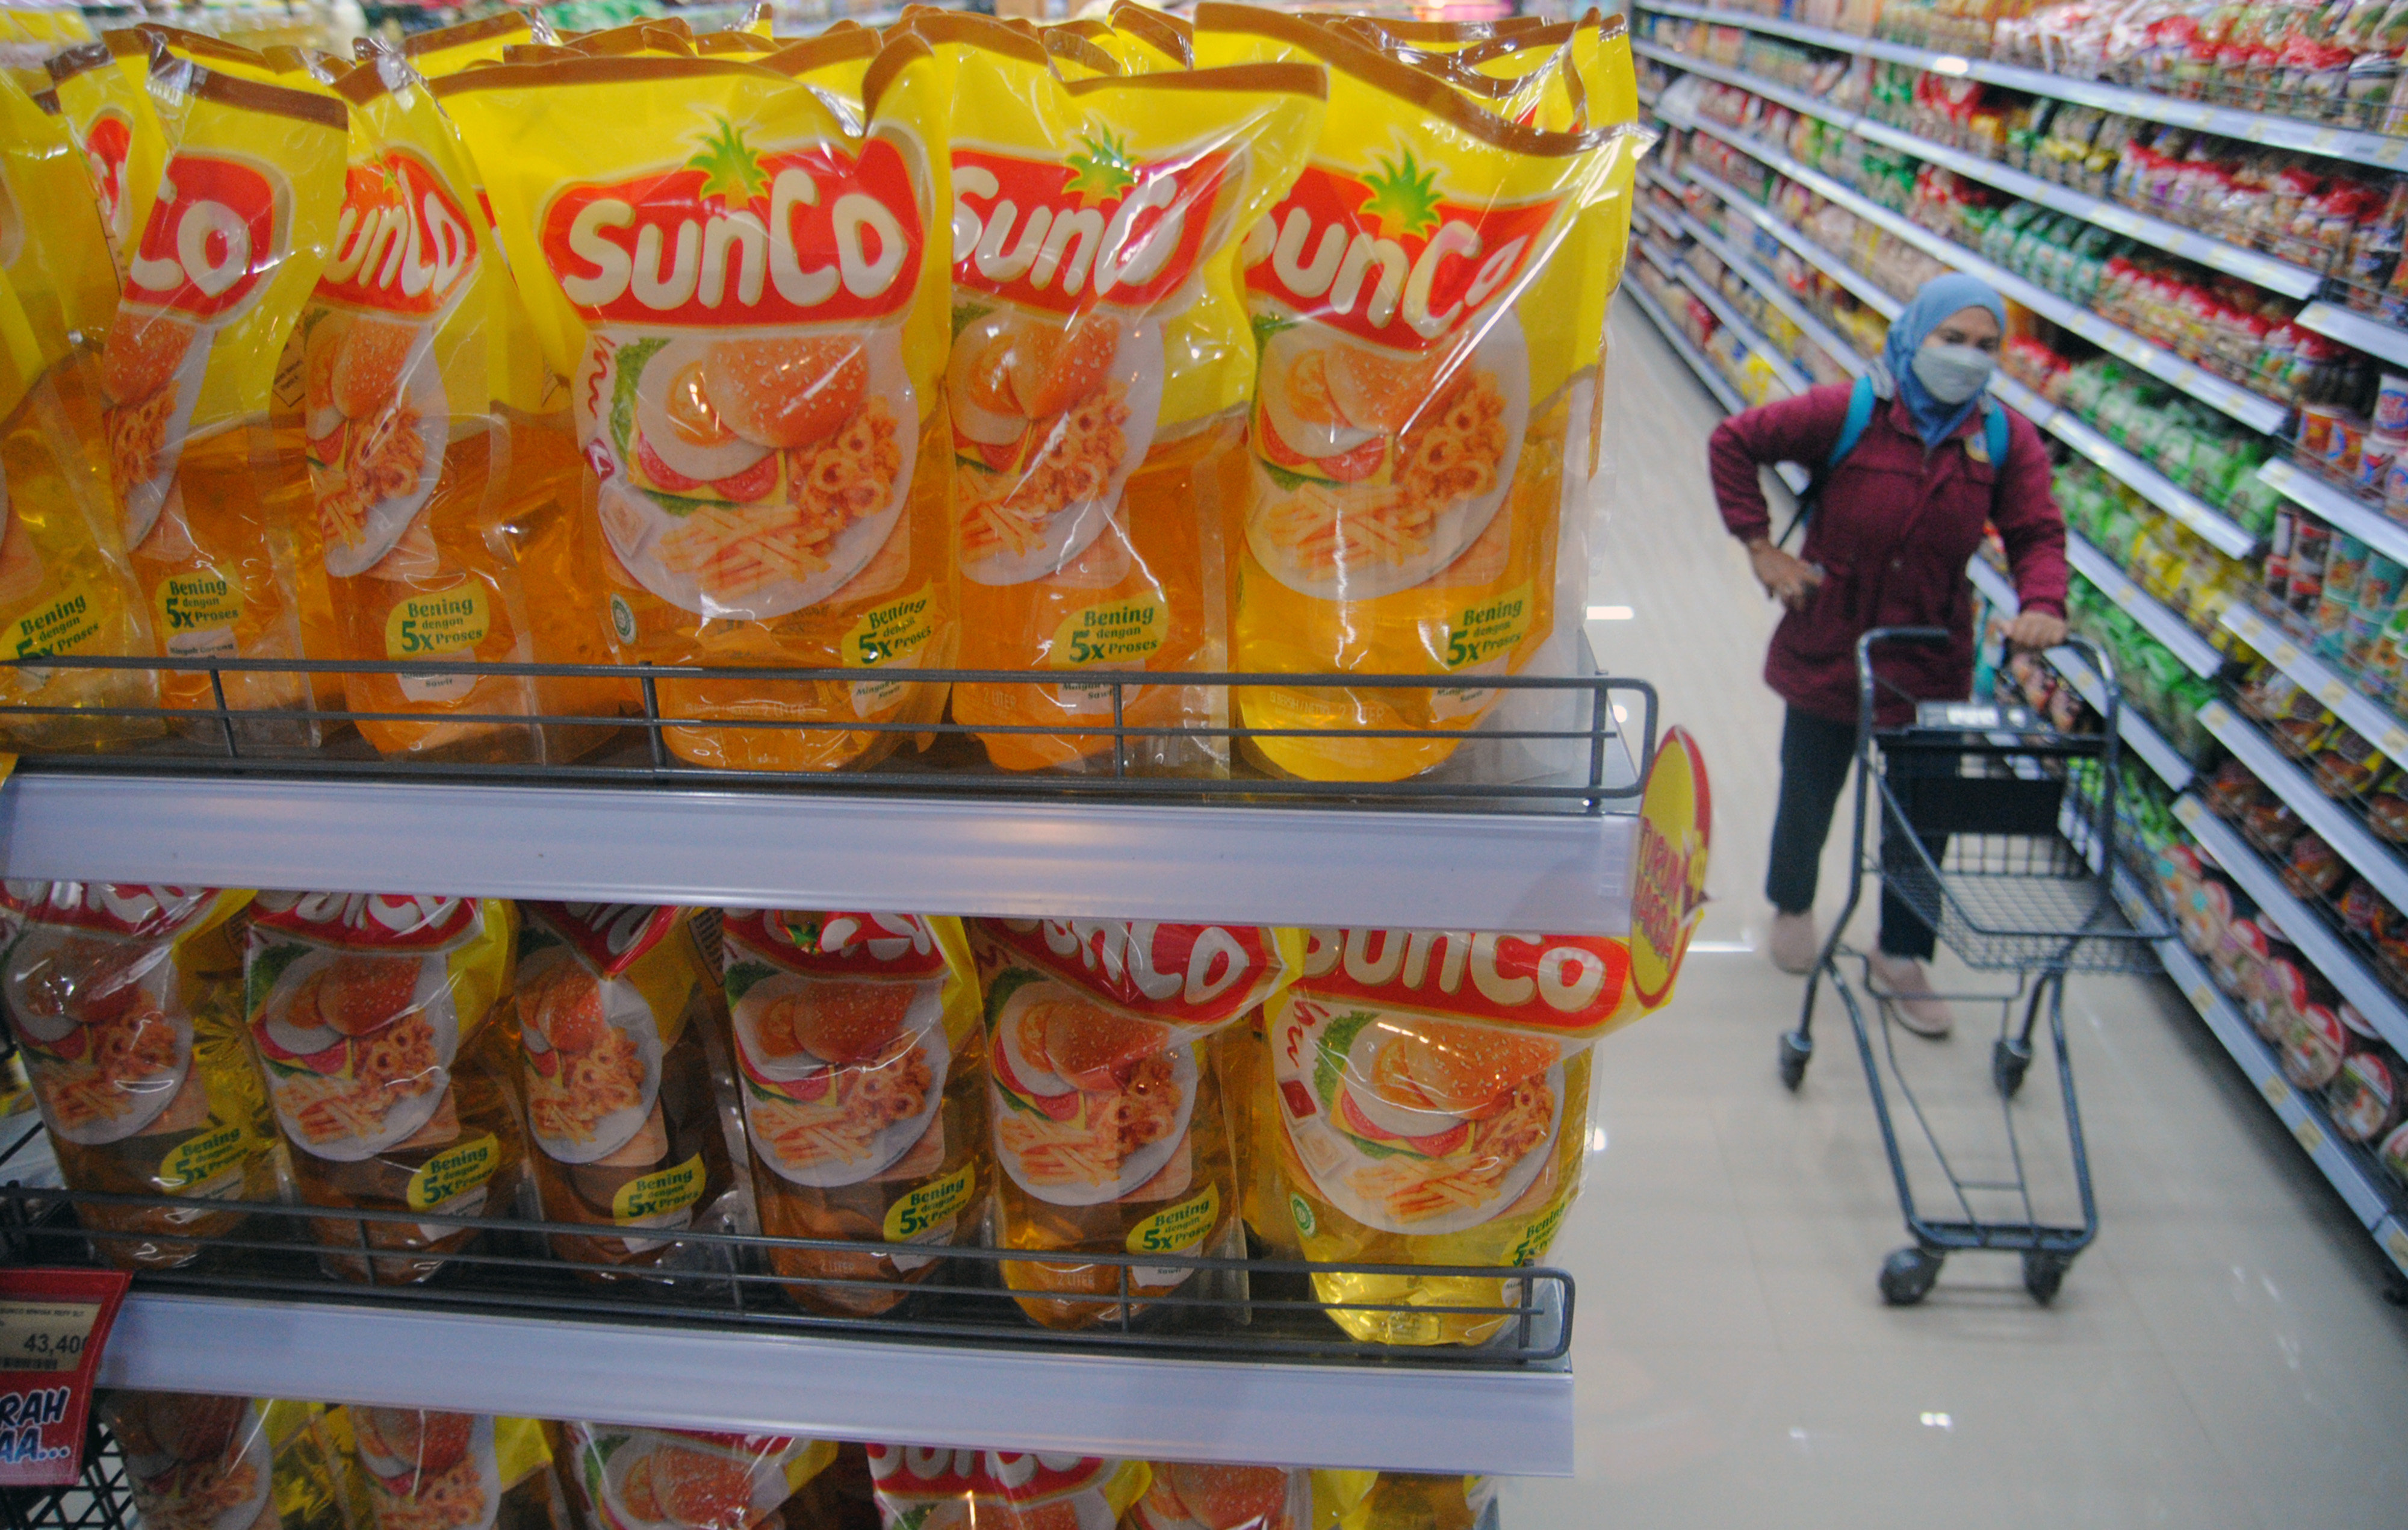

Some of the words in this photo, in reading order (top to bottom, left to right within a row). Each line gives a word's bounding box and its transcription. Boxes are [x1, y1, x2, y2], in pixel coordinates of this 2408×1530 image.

[564, 168, 908, 311] SunCo
[169, 579, 228, 596] Bening
[20, 595, 86, 636] Bening
[166, 597, 195, 628] 5x
[195, 609, 238, 623] Proses
[408, 598, 473, 618] Bening
[869, 599, 927, 630] Bening
[1084, 606, 1154, 627] Bening
[1464, 600, 1523, 626] Bening
[39, 617, 80, 642] dengan
[57, 623, 99, 651] Proses
[402, 620, 435, 652] 5x
[436, 629, 482, 644] Proses
[1097, 626, 1141, 639] dengan
[859, 632, 892, 664] 5x
[895, 626, 931, 648] Proses
[1069, 629, 1105, 663] 5x
[1108, 639, 1158, 654] Proses
[1447, 630, 1480, 666] 5x
[430, 1146, 488, 1174] Bening
[423, 1175, 453, 1203] 5x
[636, 1169, 692, 1191] Bening
[911, 1178, 964, 1205] Bening
[899, 1208, 929, 1234] 5x
[1155, 1200, 1209, 1227] Bening
[1142, 1228, 1172, 1250] 5x
